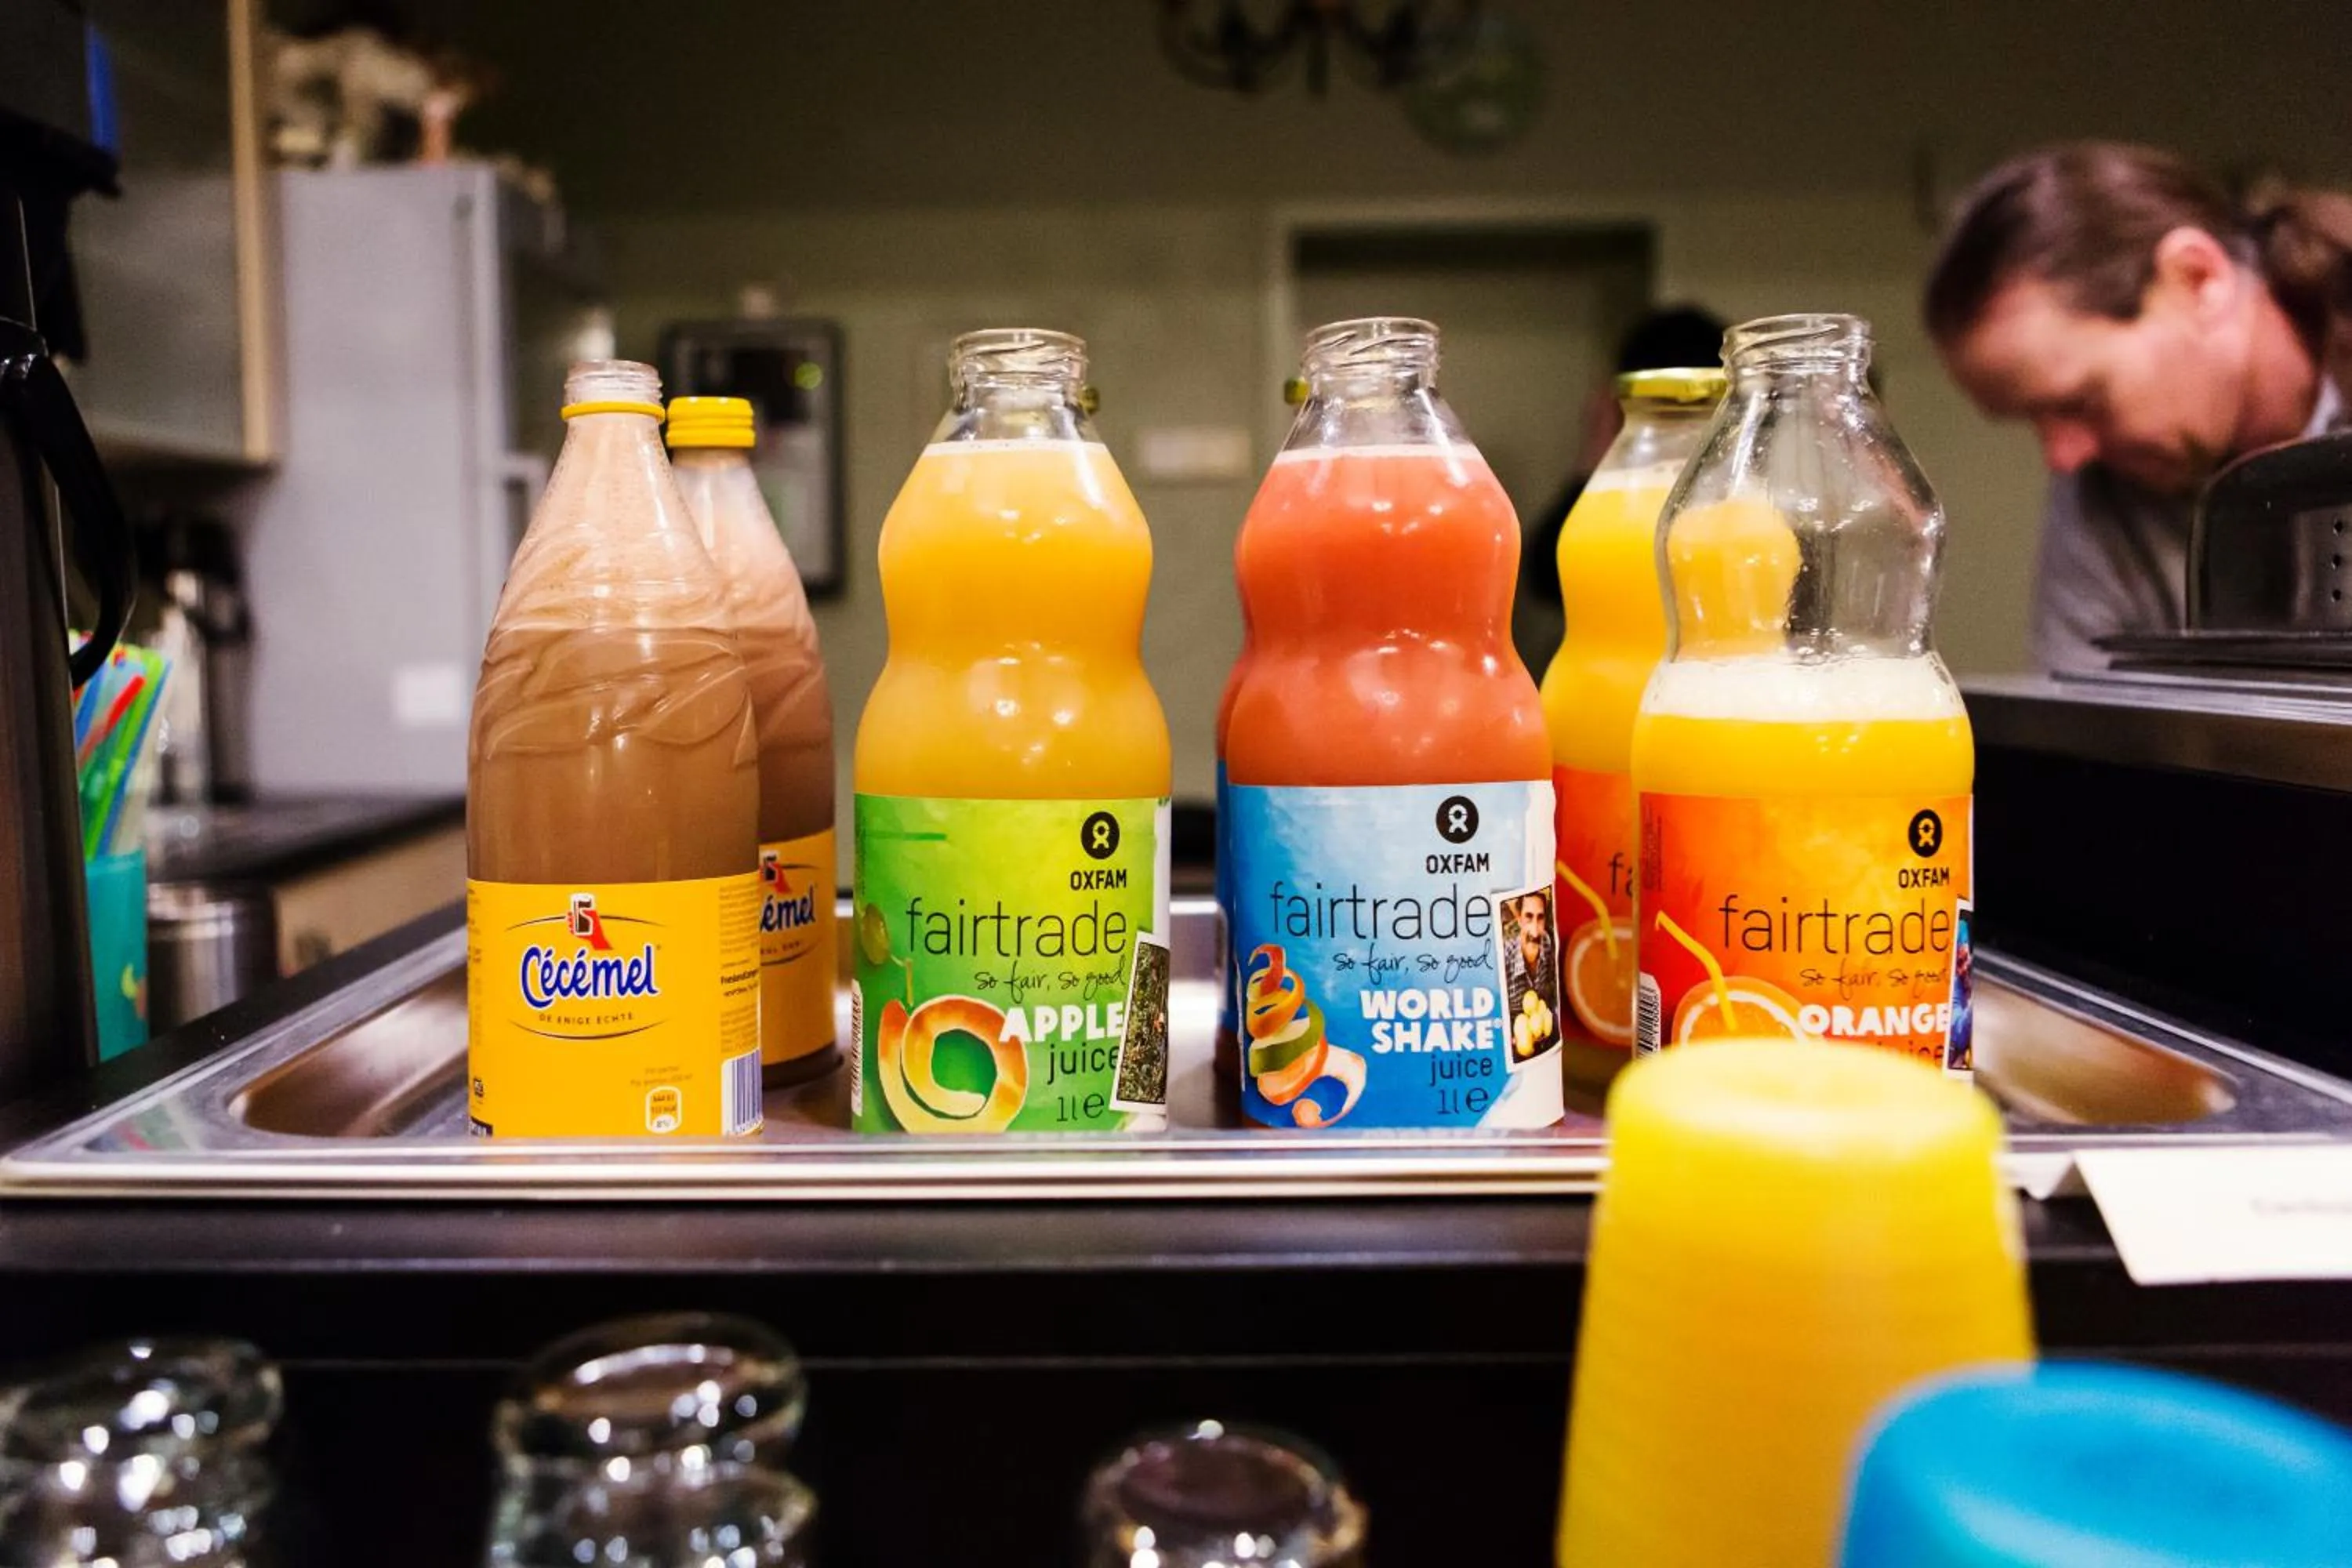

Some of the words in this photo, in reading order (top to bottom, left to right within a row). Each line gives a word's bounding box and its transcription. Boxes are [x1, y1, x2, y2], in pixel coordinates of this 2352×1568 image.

[1070, 869, 1127, 892] OXFAM
[1425, 853, 1490, 875] OXFAM
[1898, 866, 1951, 889] OXFAM
[906, 896, 1127, 957] fairtrade
[1269, 880, 1491, 940] fairtrade
[1718, 895, 1951, 956] fairtrade
[521, 944, 659, 1009] Cécémel
[1083, 955, 1127, 1001] good
[1445, 938, 1494, 984] good
[539, 1012, 552, 1024] DE
[557, 1014, 590, 1025] ENIGE
[596, 1010, 633, 1025] ECHTE
[1359, 987, 1495, 1020] WORLD
[1798, 1003, 1950, 1036] ORANGE
[999, 1002, 1124, 1044] APPLE
[1371, 1019, 1494, 1053] SHAKE
[1047, 1041, 1120, 1086] juice
[1429, 1052, 1493, 1087] juice
